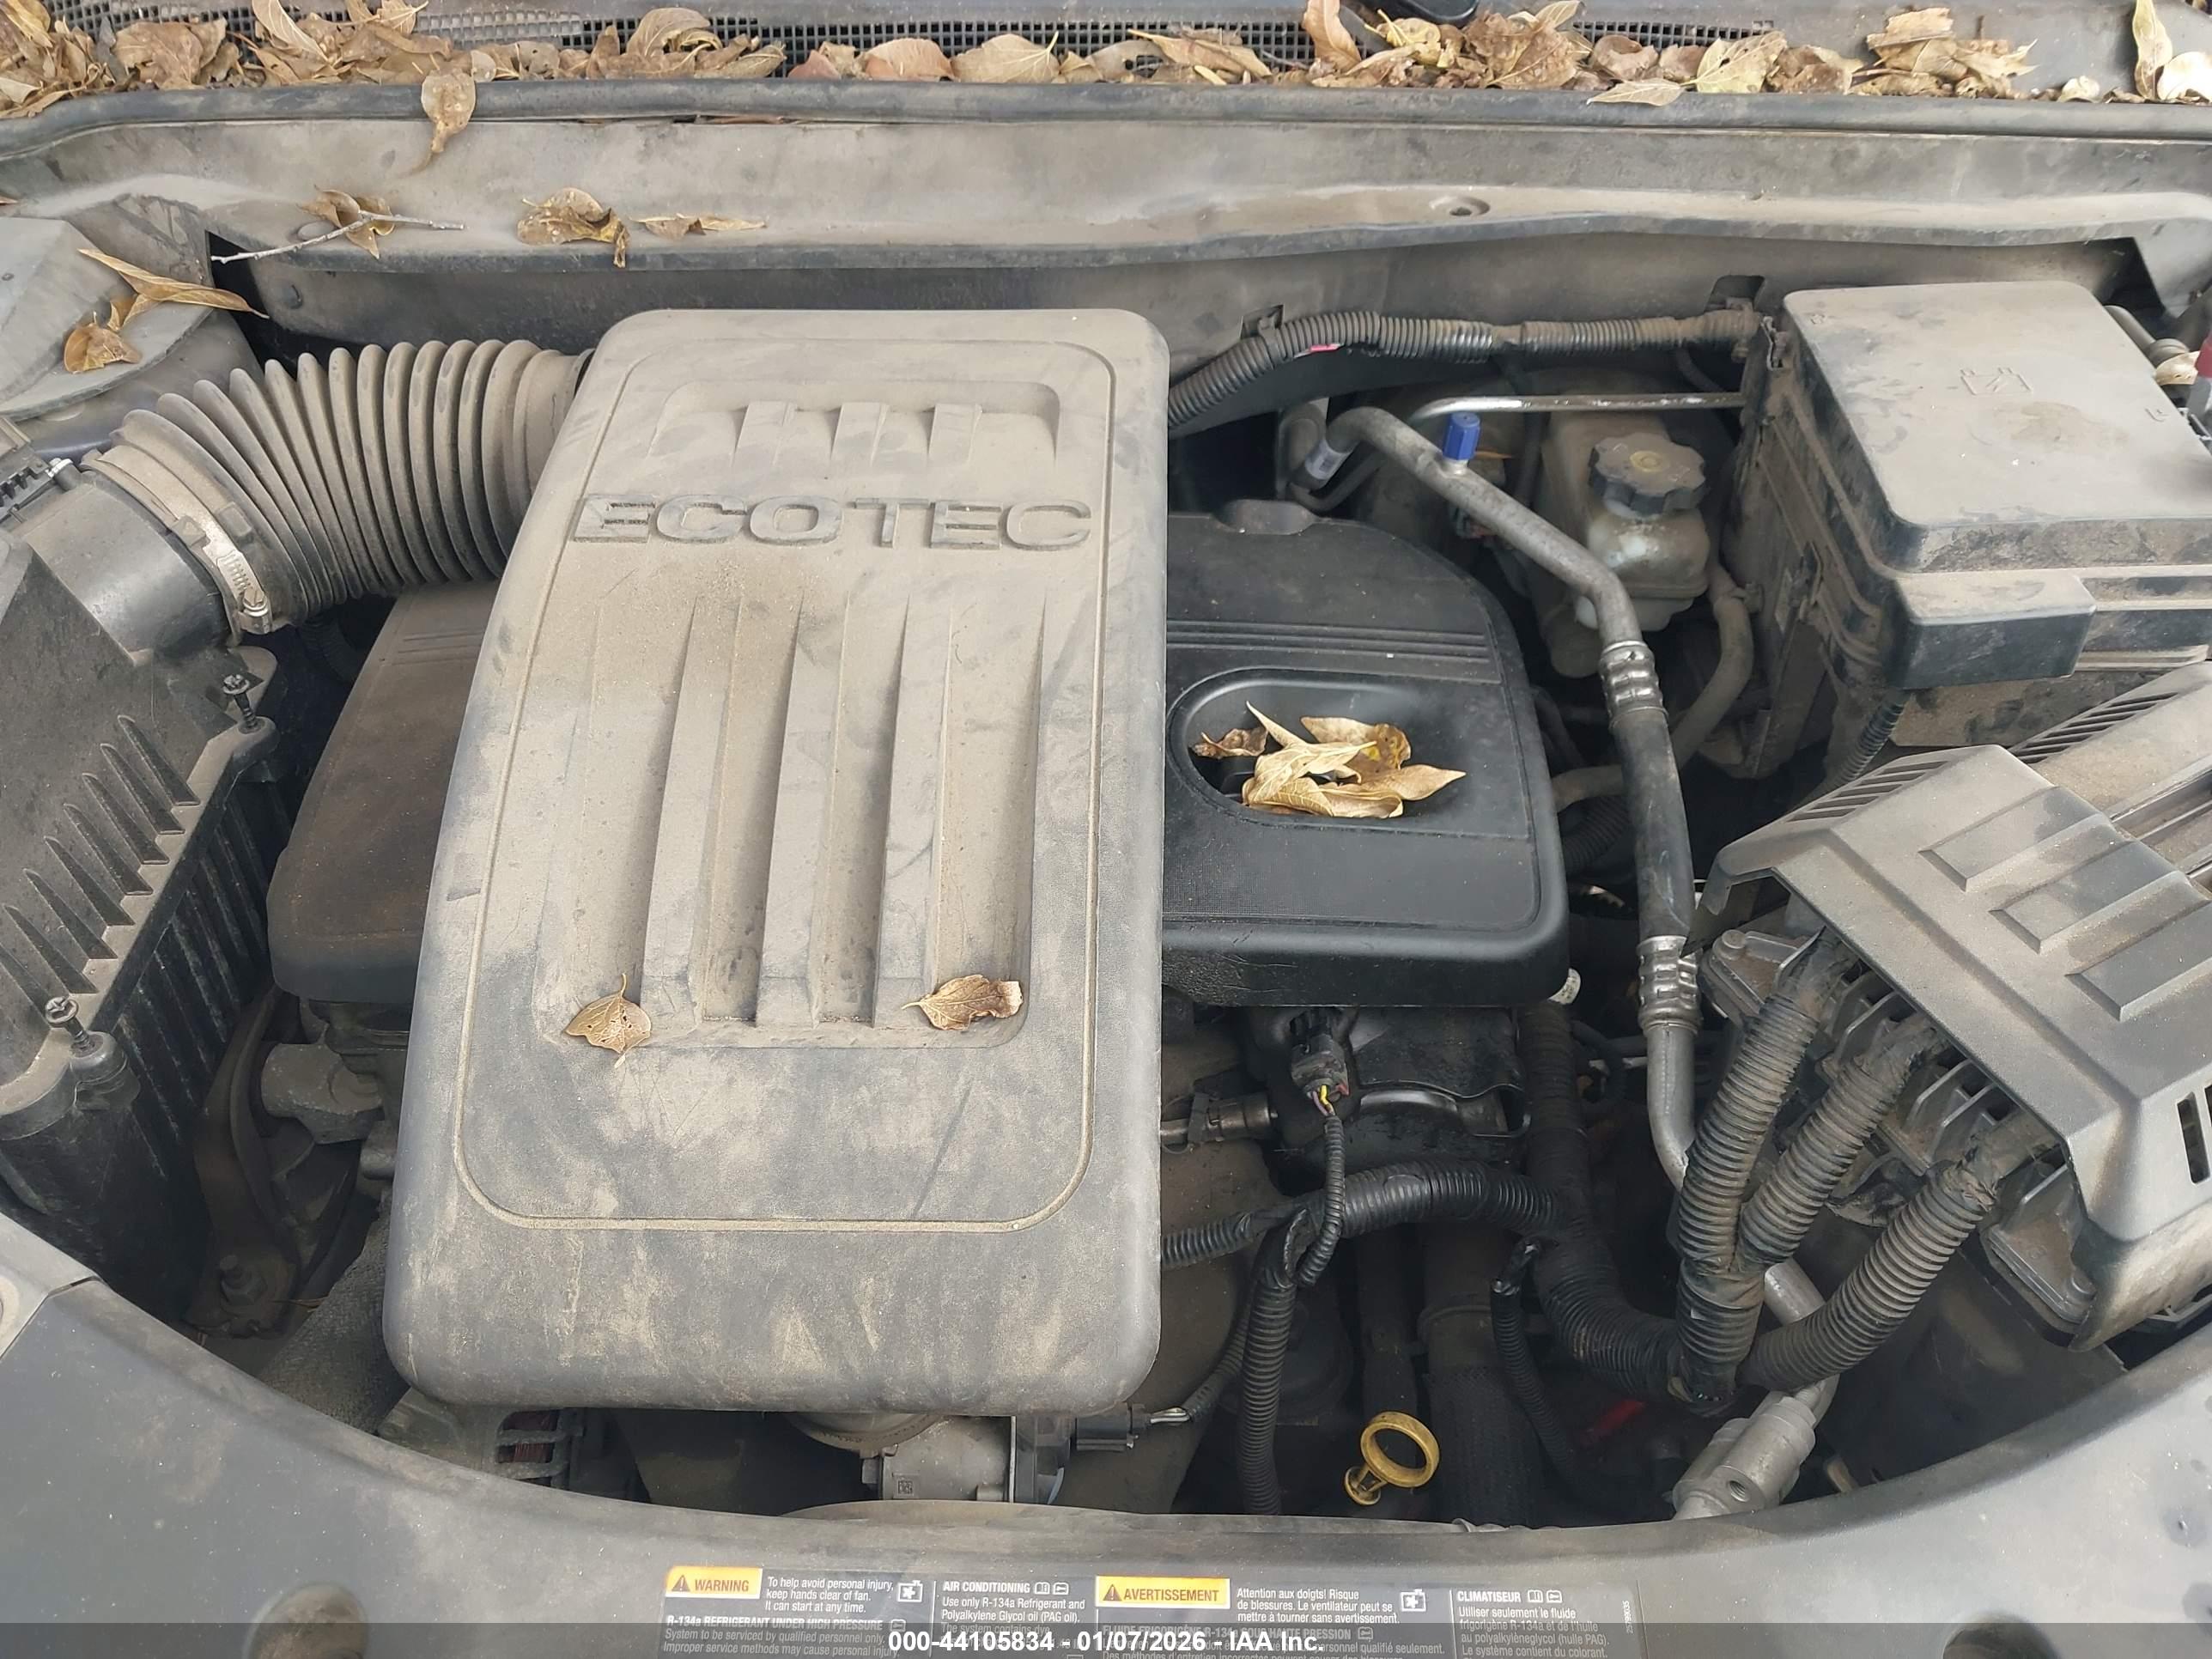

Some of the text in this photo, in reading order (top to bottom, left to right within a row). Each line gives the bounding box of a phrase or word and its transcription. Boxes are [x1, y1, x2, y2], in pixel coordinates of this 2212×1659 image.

[572, 494, 1093, 552] ECOTEC
[694, 1579, 750, 1593] WARNING
[768, 1577, 894, 1592] To help avoid personal injury,
[943, 1581, 1031, 1594] AIR CONDITIONING
[766, 1589, 872, 1601] keep hands clear of fan.
[1123, 1589, 1220, 1602] AVERTISSEMENT
[1237, 1588, 1359, 1601] Attention aux doigts! Risque
[1457, 1590, 1522, 1603] CLIMATISEUR
[764, 1601, 866, 1614] It can start at any time.
[943, 1596, 1085, 1611] Use only R-134a Refrigerant and
[1237, 1600, 1393, 1614] de blessures. Le ventilateur peut se
[941, 1609, 1080, 1624] Polyalkylene Glycol oil (PAG oil).
[1237, 1612, 1267, 1622] mettre
[1277, 1613, 1310, 1623] tourner
[1312, 1614, 1333, 1623] sans
[1334, 1613, 1401, 1624] avertissement.
[1459, 1606, 1577, 1619] Utiliser seulement le fluide
[666, 1615, 884, 1631] R-134a REFRIGERANT UNDER HIGH PRESSURE
[1460, 1619, 1508, 1632] frigorigène
[1510, 1620, 1544, 1631] R-134a
[1547, 1621, 1555, 1632] et
[1558, 1620, 1569, 1632] de
[665, 1628, 885, 1645] System to be serviced by qualified personnel only.
[1303, 1628, 1352, 1640] PRESSION
[1461, 1633, 1473, 1643] au
[1558, 1633, 1583, 1646] (huile
[1585, 1634, 1610, 1647] PAG).
[663, 1641, 704, 1654] Improper
[706, 1643, 738, 1653] service
[740, 1644, 780, 1655] methods
[781, 1645, 802, 1656] may
[804, 1646, 830, 1656] cause
[832, 1646, 871, 1657] personal
[1359, 1642, 1393, 1654] qualifié
[1395, 1644, 1445, 1655] seulement.
[1462, 1645, 1608, 1658] Le système contient du colorant.
